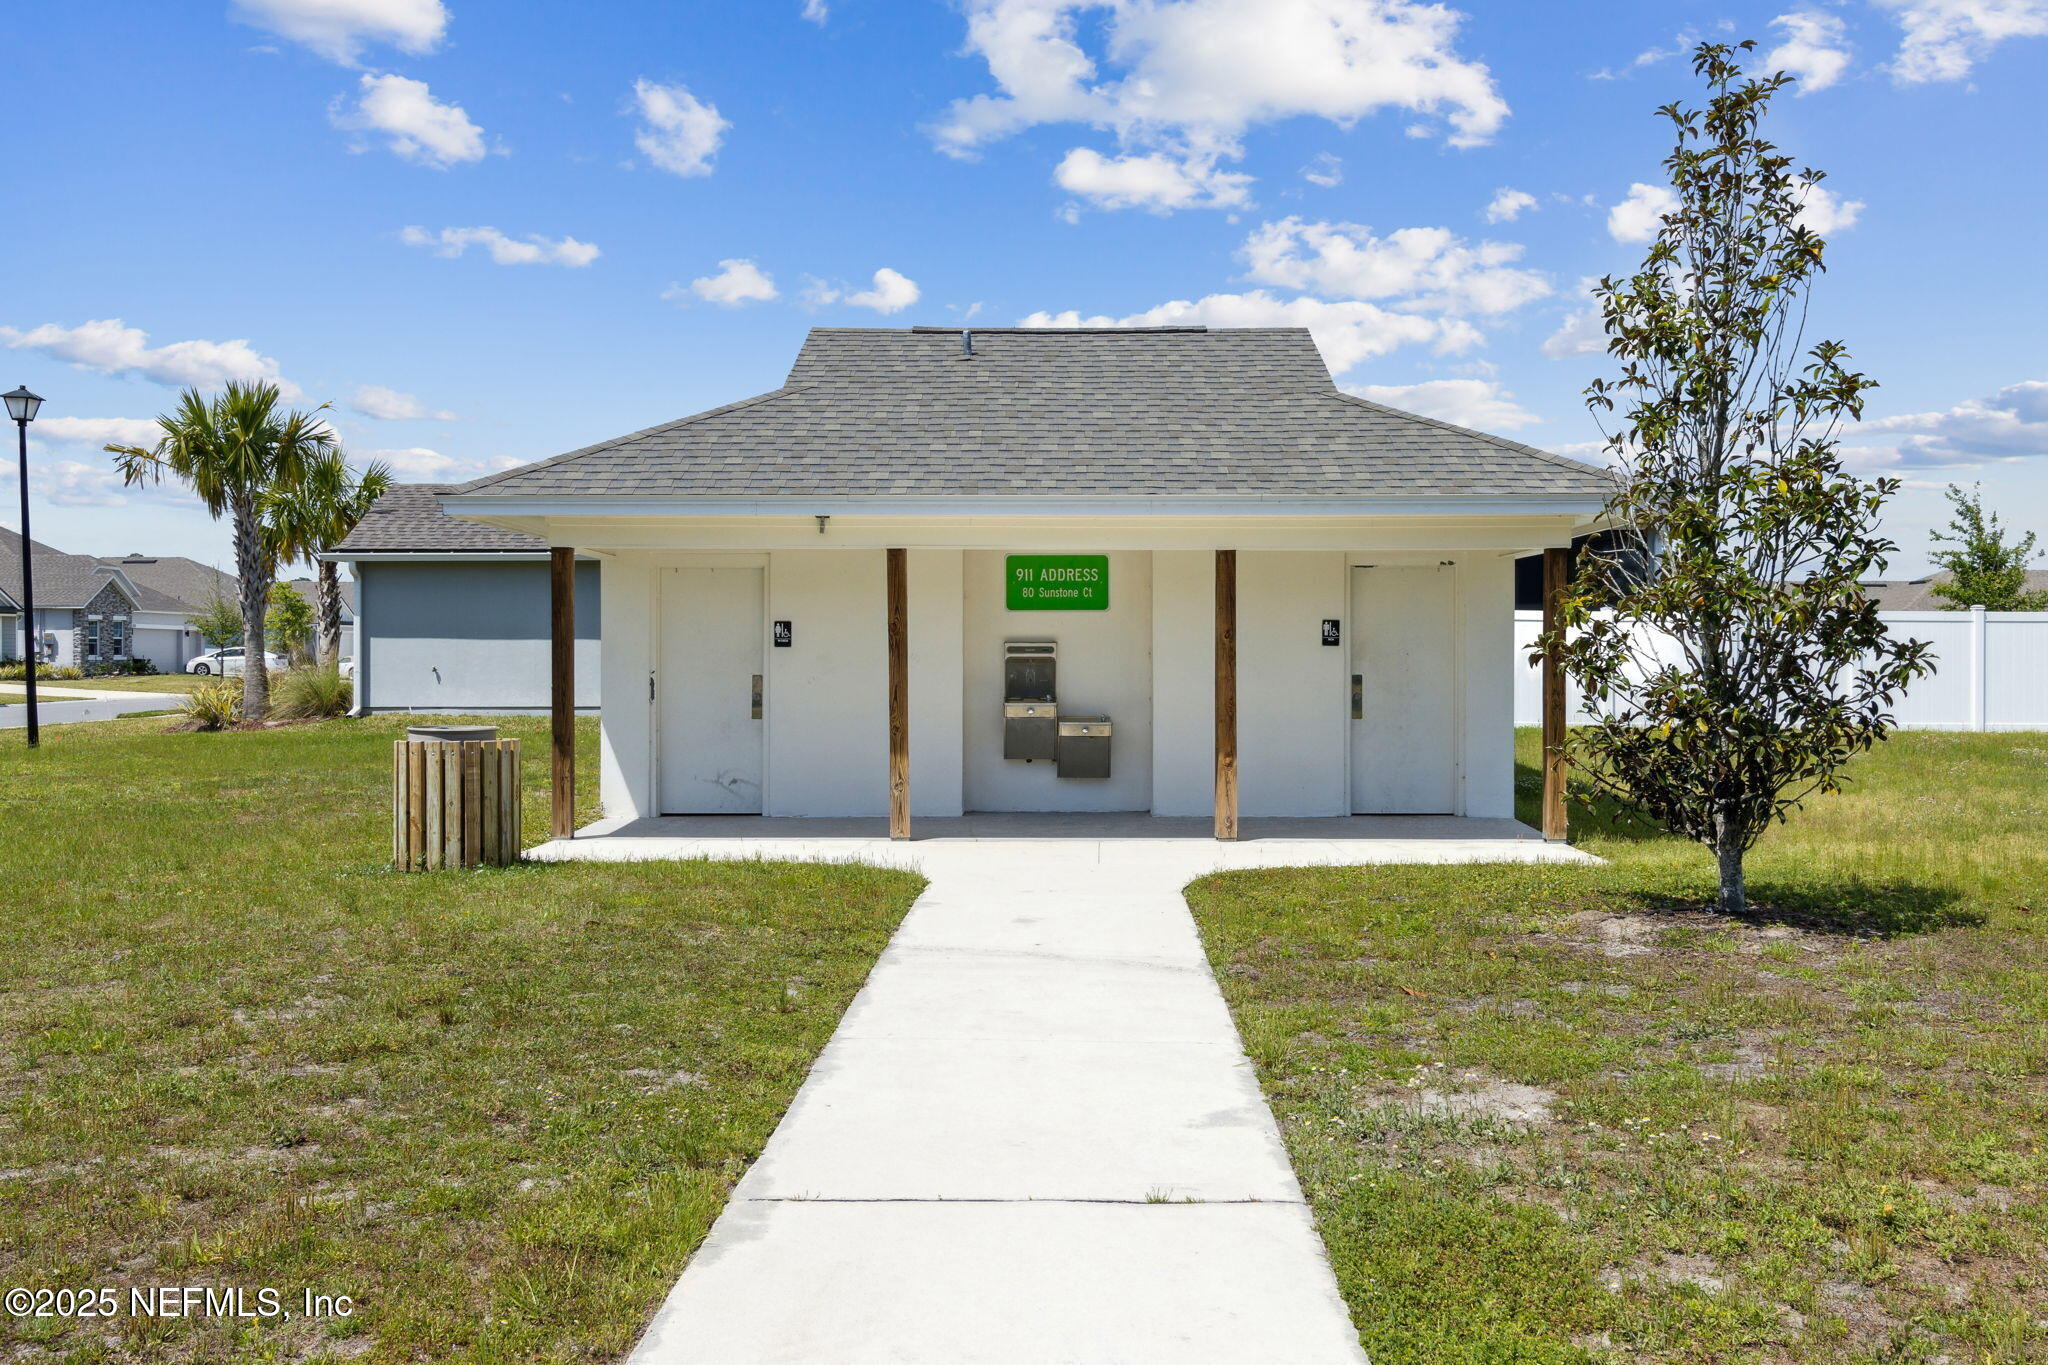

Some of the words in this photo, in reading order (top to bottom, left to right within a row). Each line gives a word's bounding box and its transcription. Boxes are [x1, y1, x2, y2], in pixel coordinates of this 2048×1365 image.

[1016, 568, 1033, 581] 911
[1040, 568, 1099, 581] ADDRESS
[1022, 587, 1035, 598] 80
[1039, 587, 1079, 598] Sunstone
[1083, 587, 1093, 598] Ct
